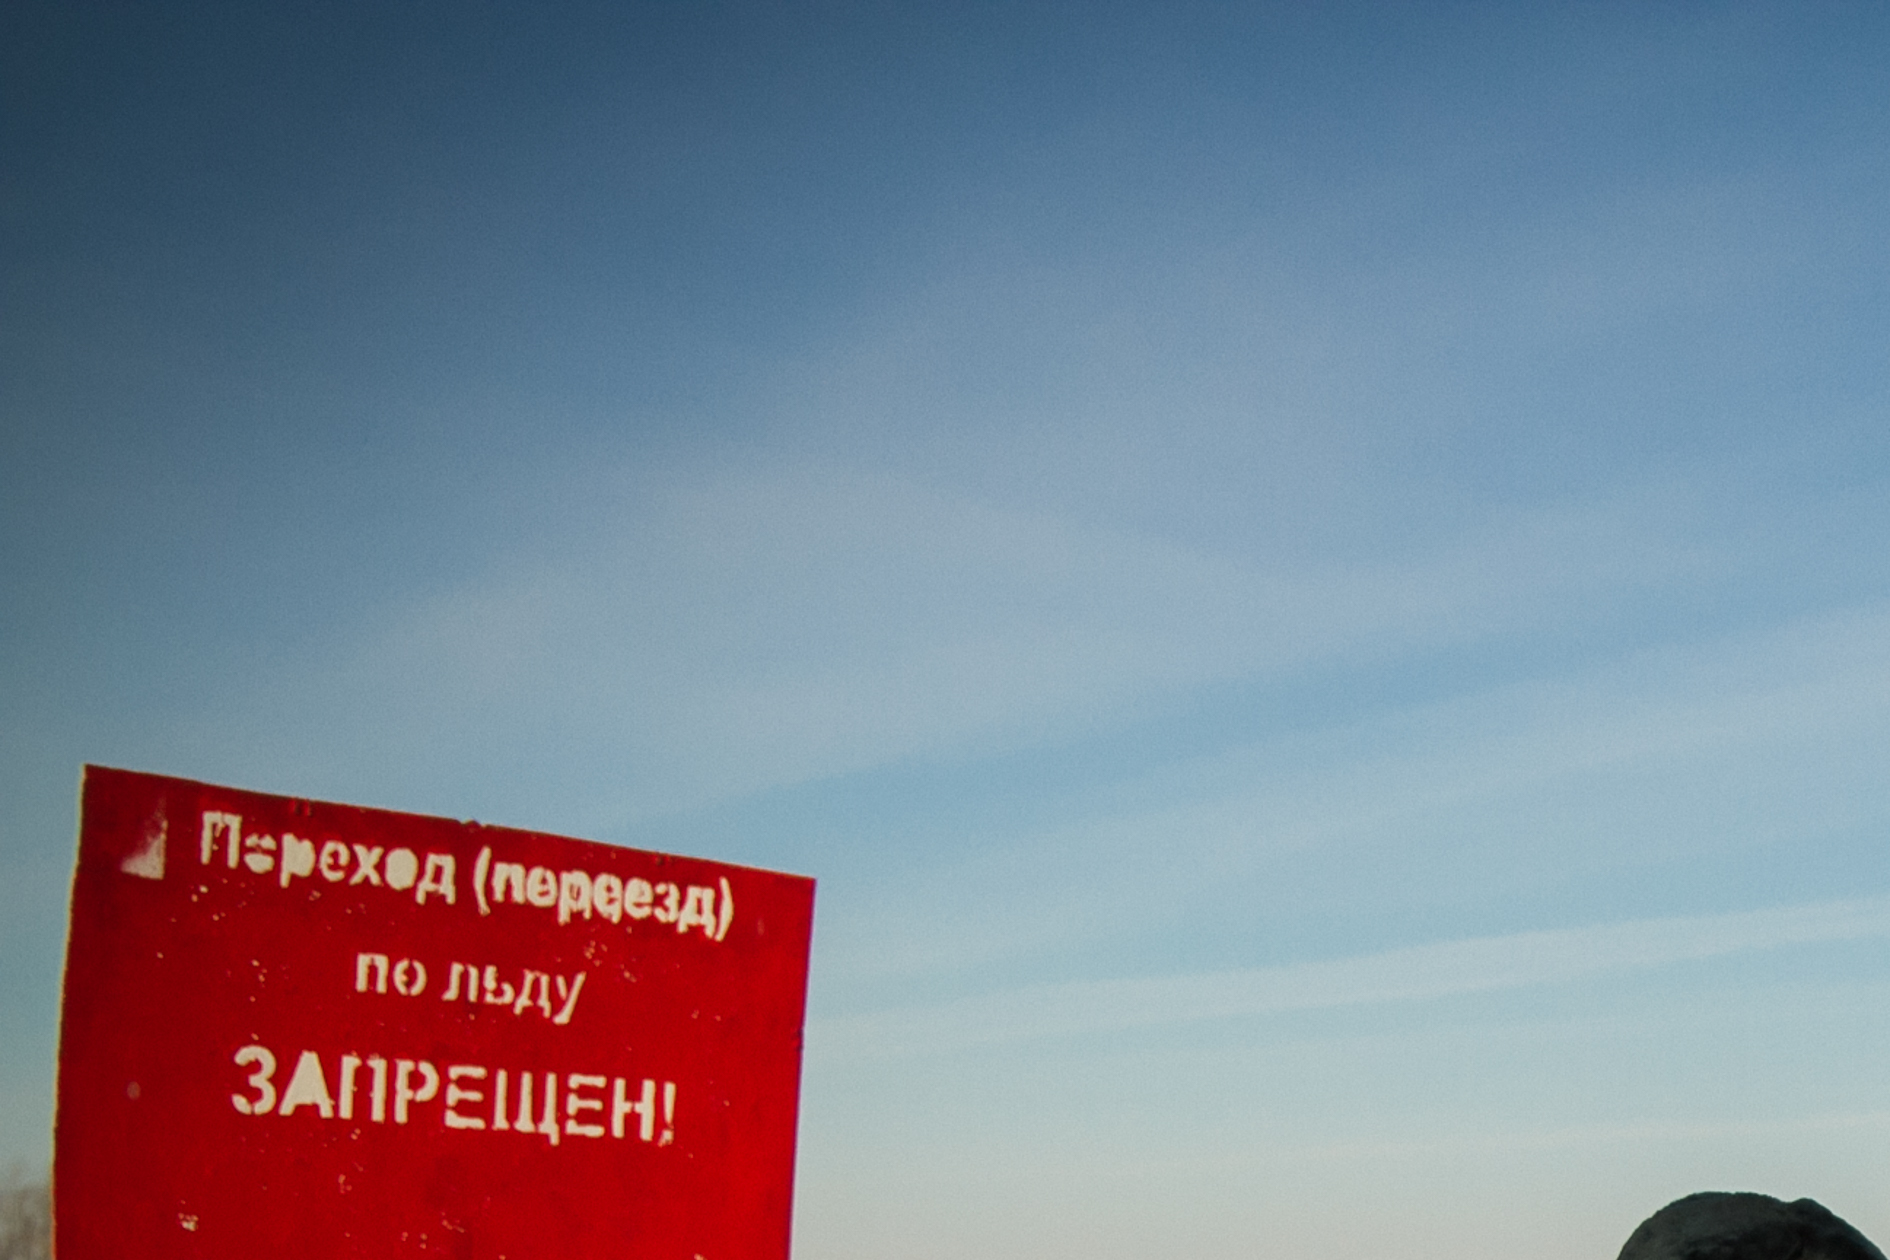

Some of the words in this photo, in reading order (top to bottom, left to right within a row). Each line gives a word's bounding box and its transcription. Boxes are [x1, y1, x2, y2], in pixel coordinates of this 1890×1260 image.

[200, 811, 456, 904] Переход
[474, 848, 734, 941] (переезд)
[355, 952, 427, 997] по
[442, 962, 587, 1025] льду
[231, 1044, 677, 1146] ЗАПРЕЩЕН!
